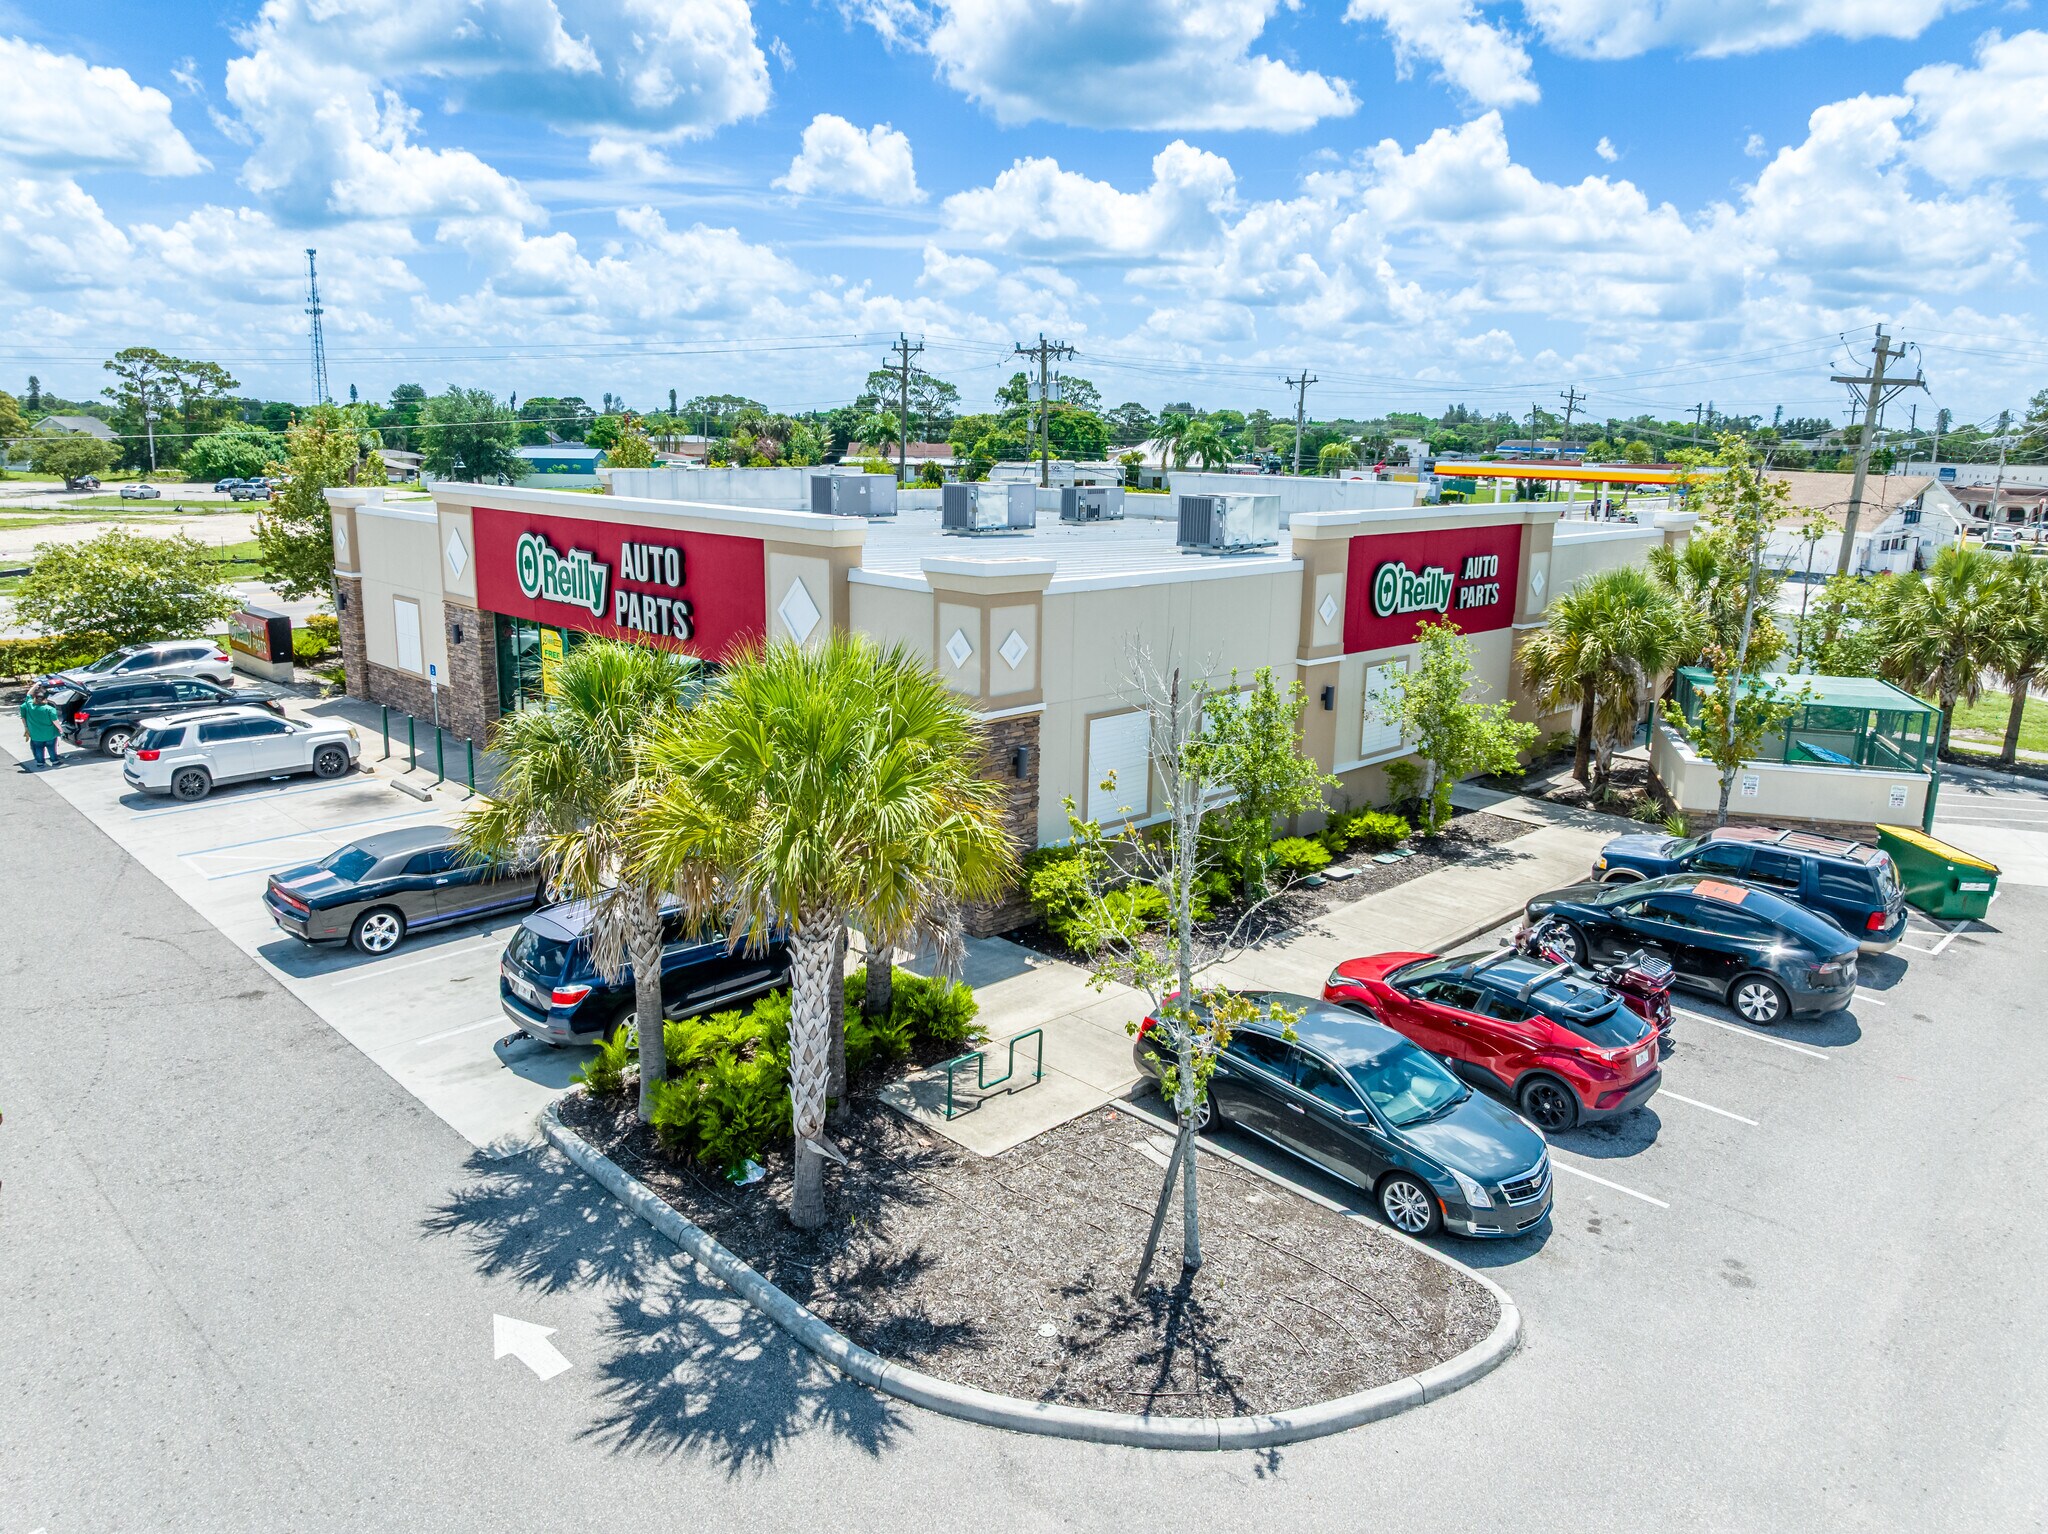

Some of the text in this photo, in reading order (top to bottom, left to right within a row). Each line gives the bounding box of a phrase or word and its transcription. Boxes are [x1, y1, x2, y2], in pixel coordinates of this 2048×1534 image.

[517, 537, 606, 612] O'Reilly
[620, 542, 682, 588] AUTO
[1464, 554, 1499, 580] AUTO
[1376, 566, 1453, 613] O'Reilly
[1459, 582, 1500, 610] PARTS
[614, 589, 690, 641] PARTS
[544, 649, 561, 660] FREE
